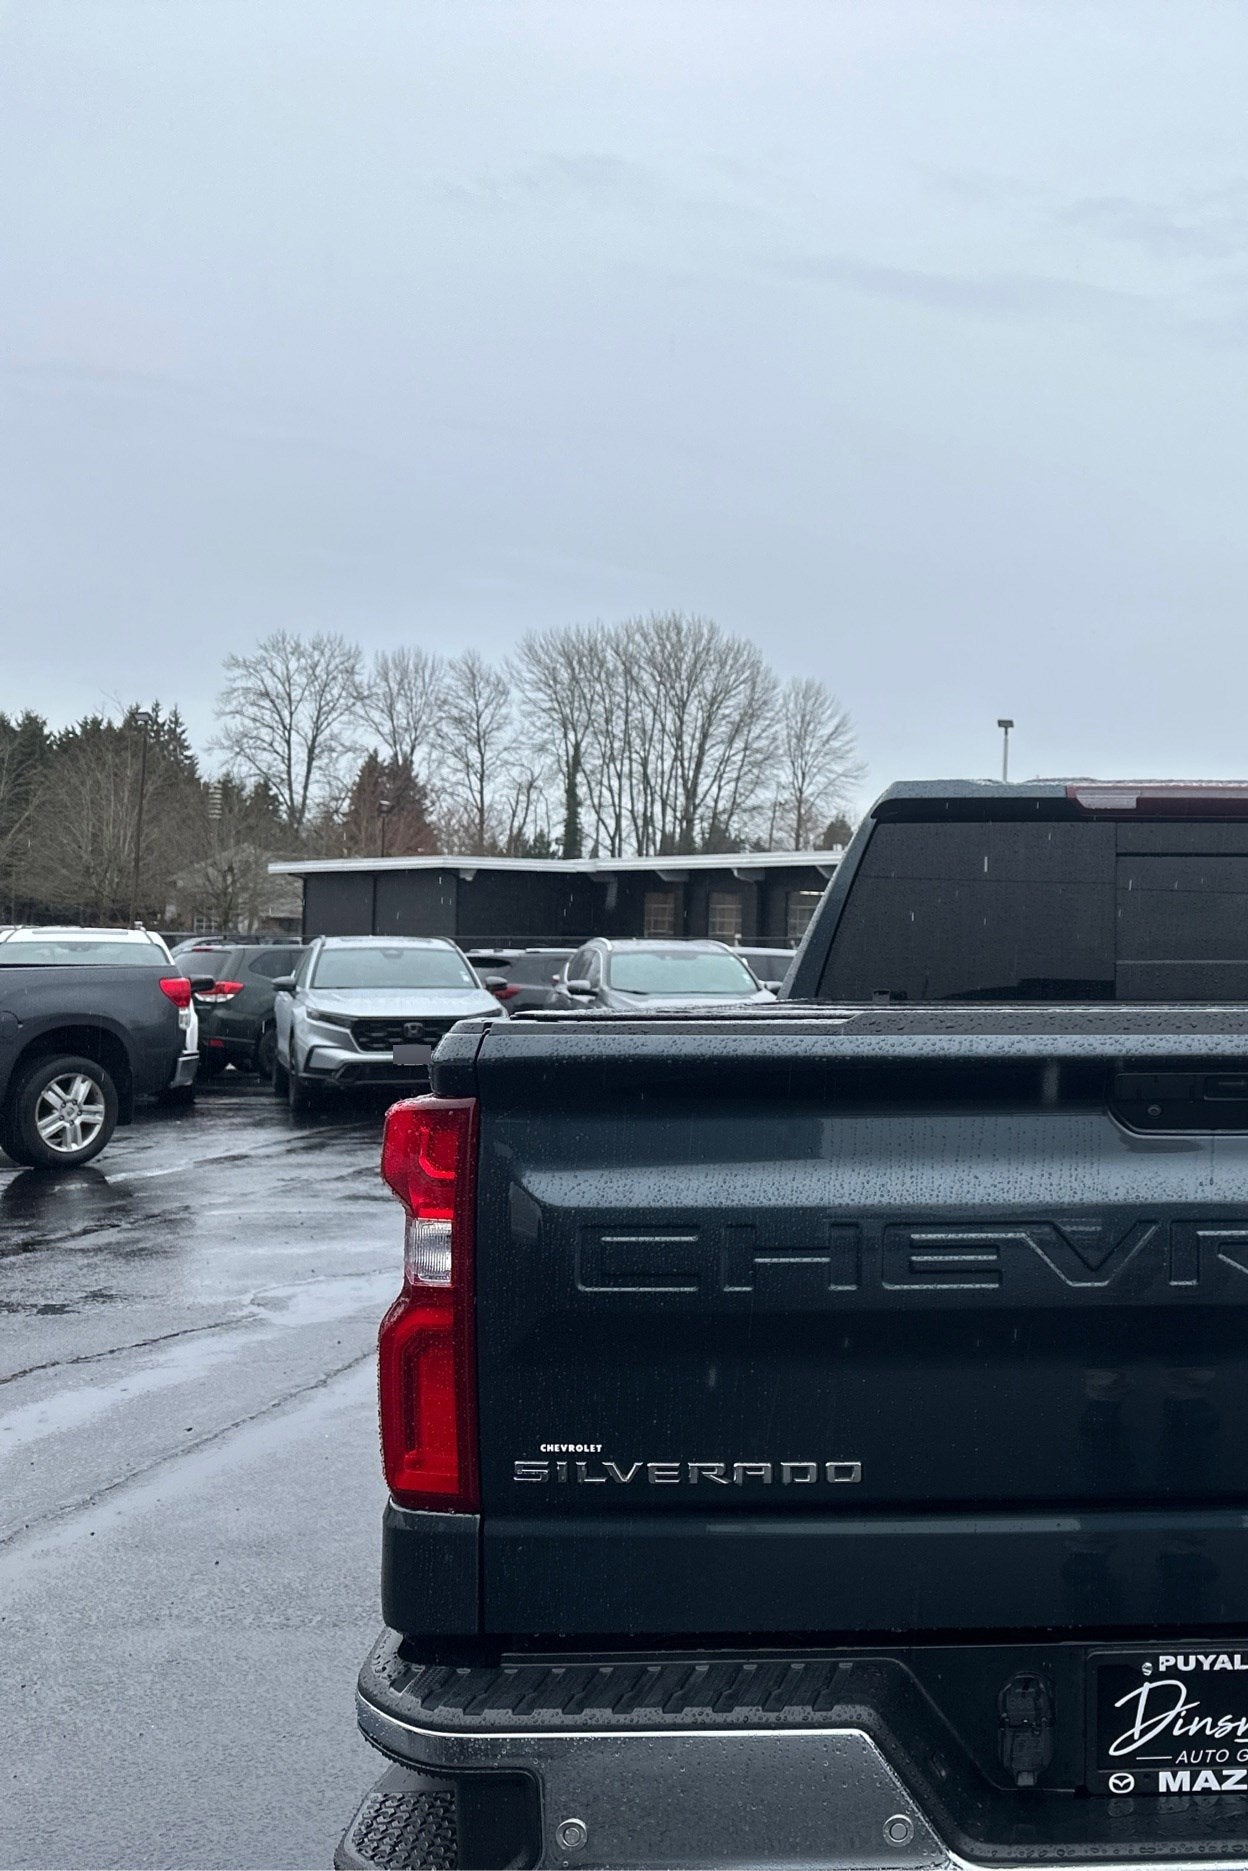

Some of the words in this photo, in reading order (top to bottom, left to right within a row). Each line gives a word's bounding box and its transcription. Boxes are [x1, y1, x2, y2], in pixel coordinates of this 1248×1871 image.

[540, 1443, 603, 1453] CHEVROLET
[513, 1460, 862, 1485] SILVERADO
[1175, 1749, 1230, 1764] AUTO
